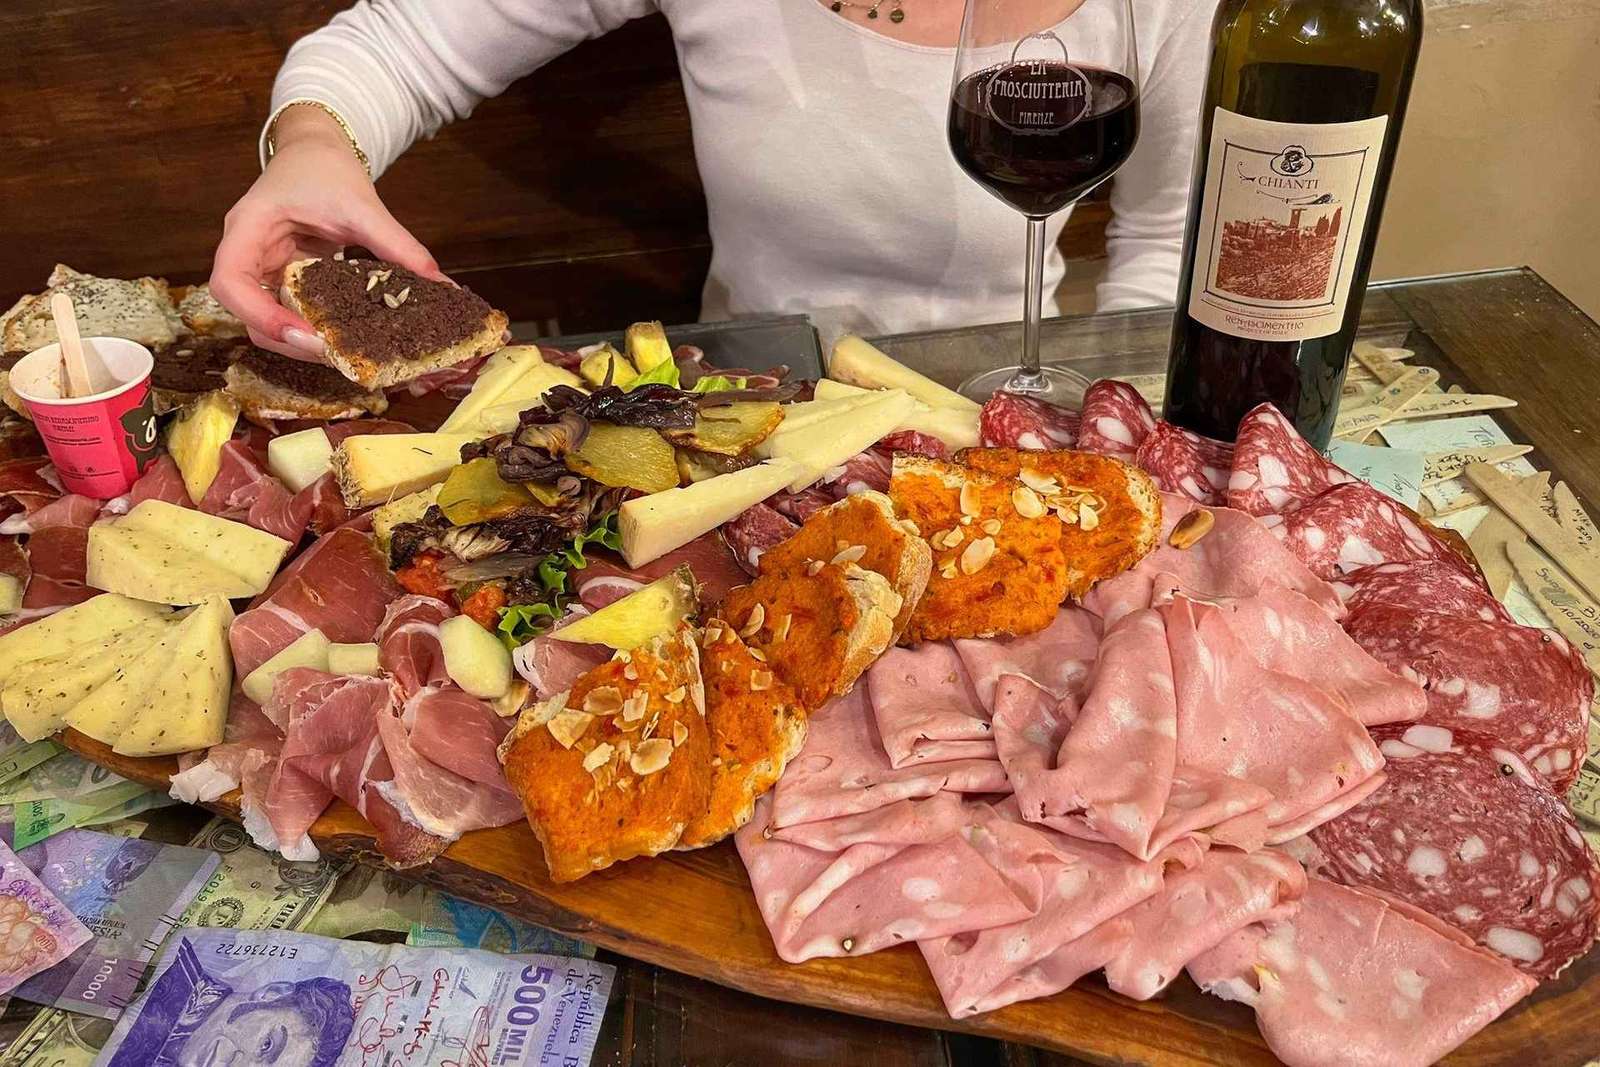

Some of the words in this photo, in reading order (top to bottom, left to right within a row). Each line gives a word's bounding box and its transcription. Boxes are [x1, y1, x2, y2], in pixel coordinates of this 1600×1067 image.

[1030, 60, 1047, 75] LA
[993, 80, 1084, 99] PROSCIUTTERIA
[1019, 112, 1055, 125] FIRENZE
[1258, 176, 1319, 190] CHIANTI
[216, 943, 298, 960] E12736722
[82, 958, 118, 1000] 10000
[565, 968, 584, 986] de
[507, 964, 554, 1026] 500
[568, 973, 603, 1045] República
[540, 990, 577, 1064] Venezuela
[499, 1028, 527, 1066] MIL
